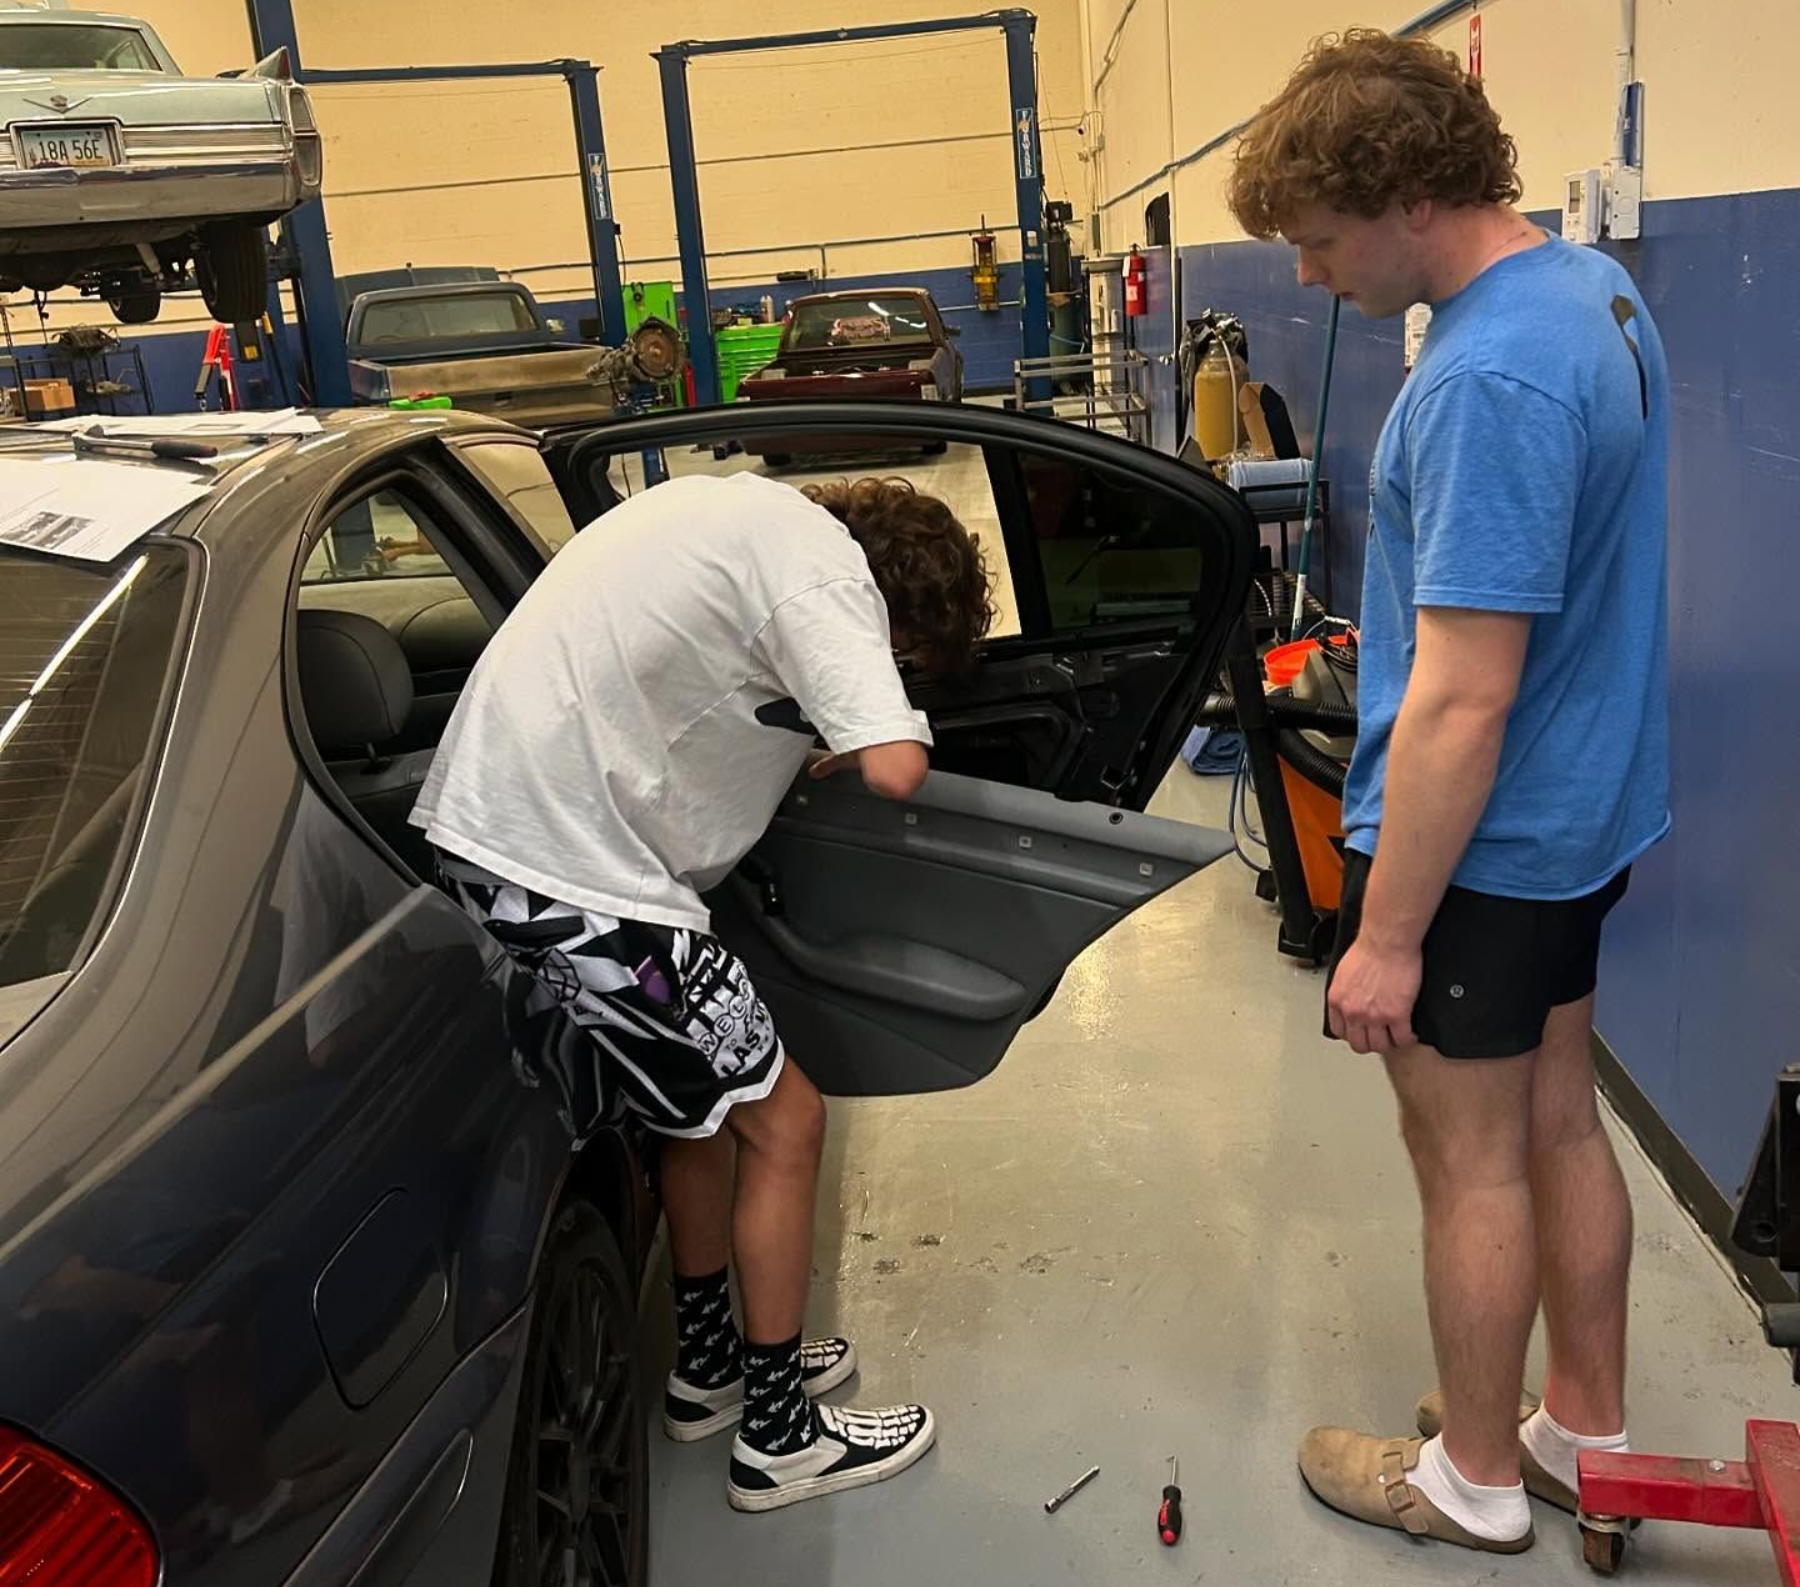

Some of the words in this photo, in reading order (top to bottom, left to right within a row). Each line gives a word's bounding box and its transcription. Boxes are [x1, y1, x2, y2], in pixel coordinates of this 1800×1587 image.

[39, 140, 70, 162] 18A
[72, 139, 104, 160] 56E
[721, 1029, 761, 1077] LAS
